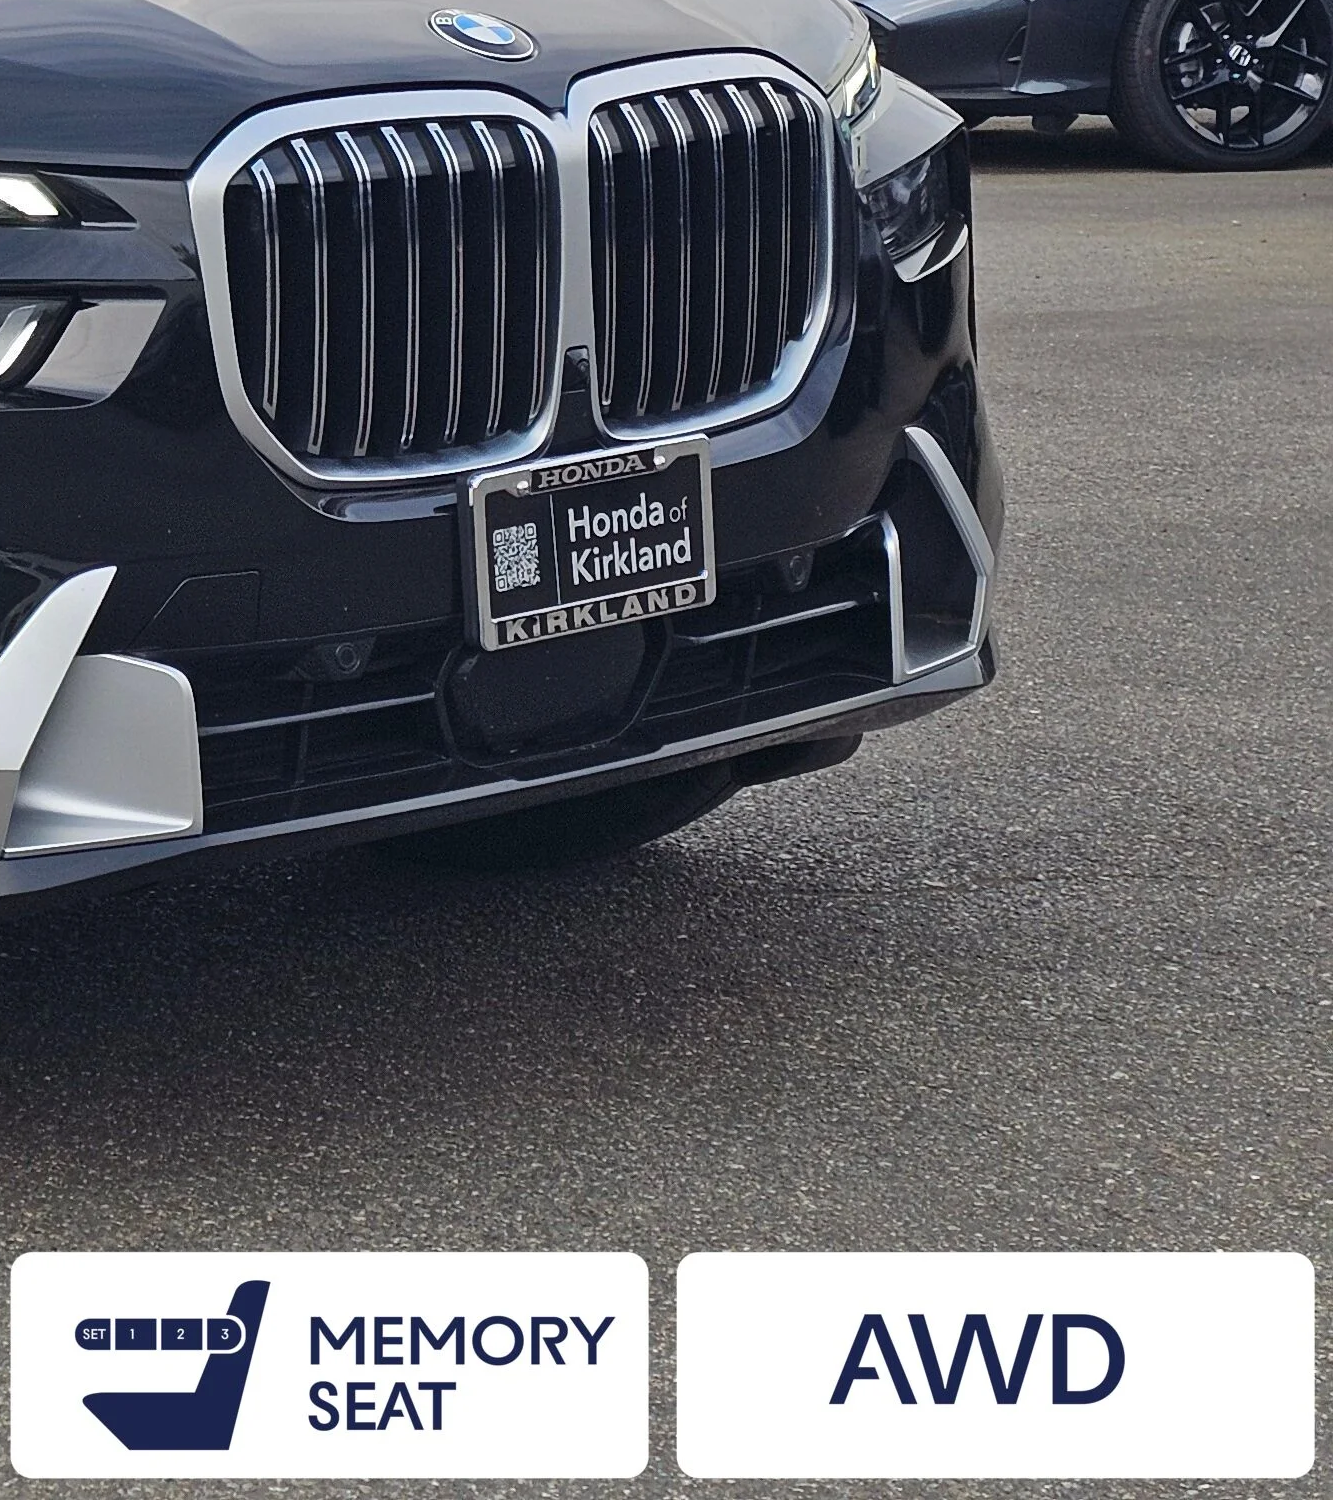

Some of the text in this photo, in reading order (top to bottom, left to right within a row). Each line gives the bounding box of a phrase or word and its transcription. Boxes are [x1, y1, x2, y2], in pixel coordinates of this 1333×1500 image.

[538, 454, 646, 488] HONDA
[568, 492, 688, 542] Honda of
[571, 526, 692, 585] Kirkland
[506, 584, 697, 643] KIRKLAND
